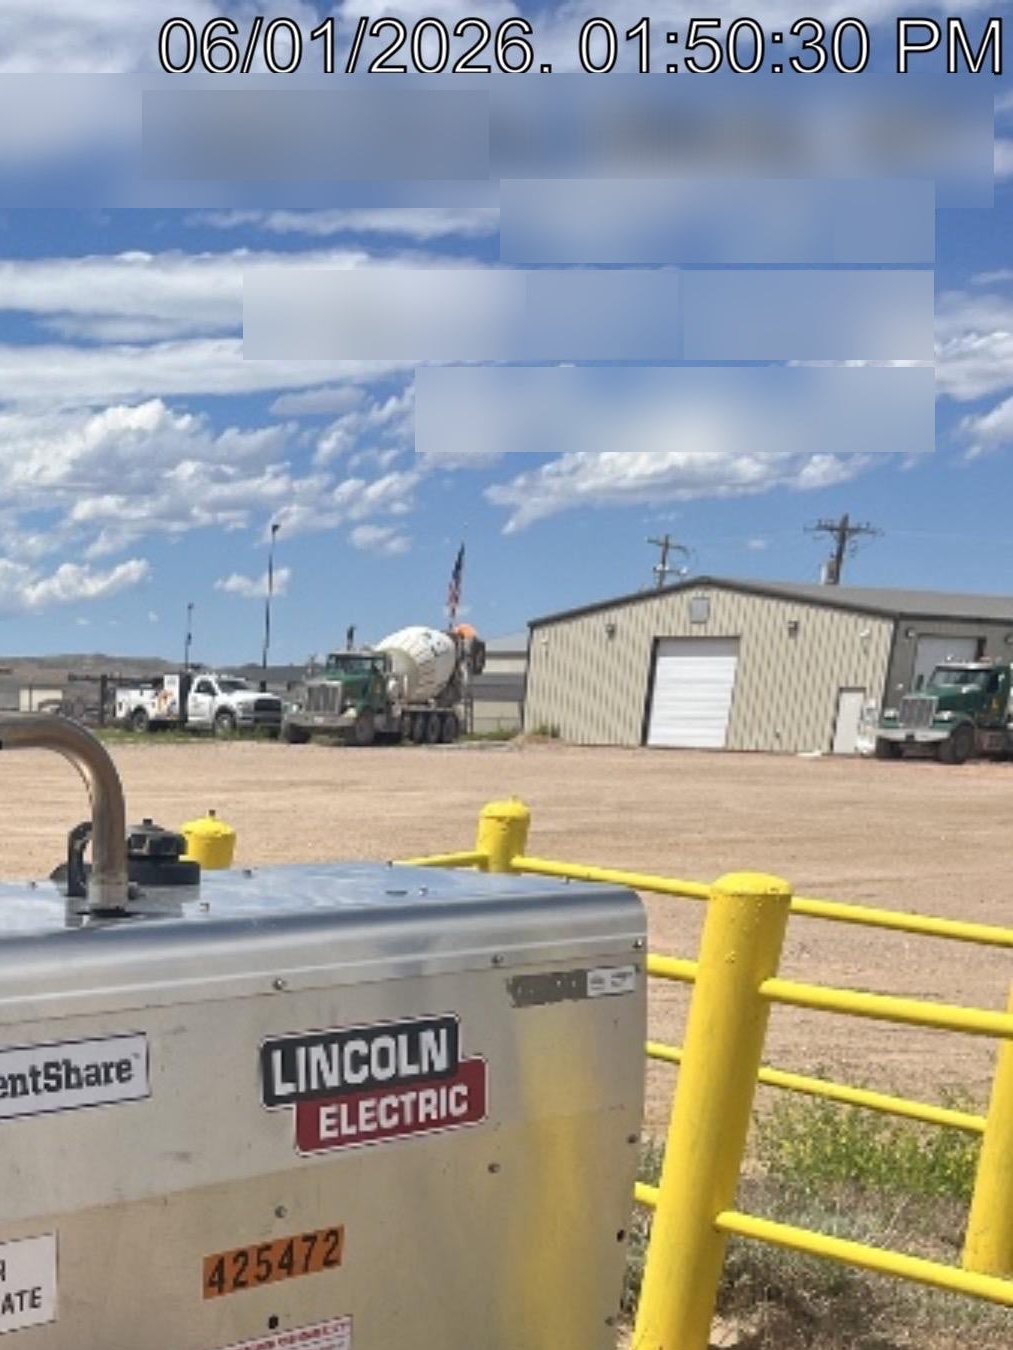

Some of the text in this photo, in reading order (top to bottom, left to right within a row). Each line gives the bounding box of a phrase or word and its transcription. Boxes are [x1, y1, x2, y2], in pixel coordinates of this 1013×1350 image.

[272, 1027, 448, 1097] LINCOLN
[318, 1083, 469, 1141] ELECTRIC
[207, 1228, 341, 1295] 425472
